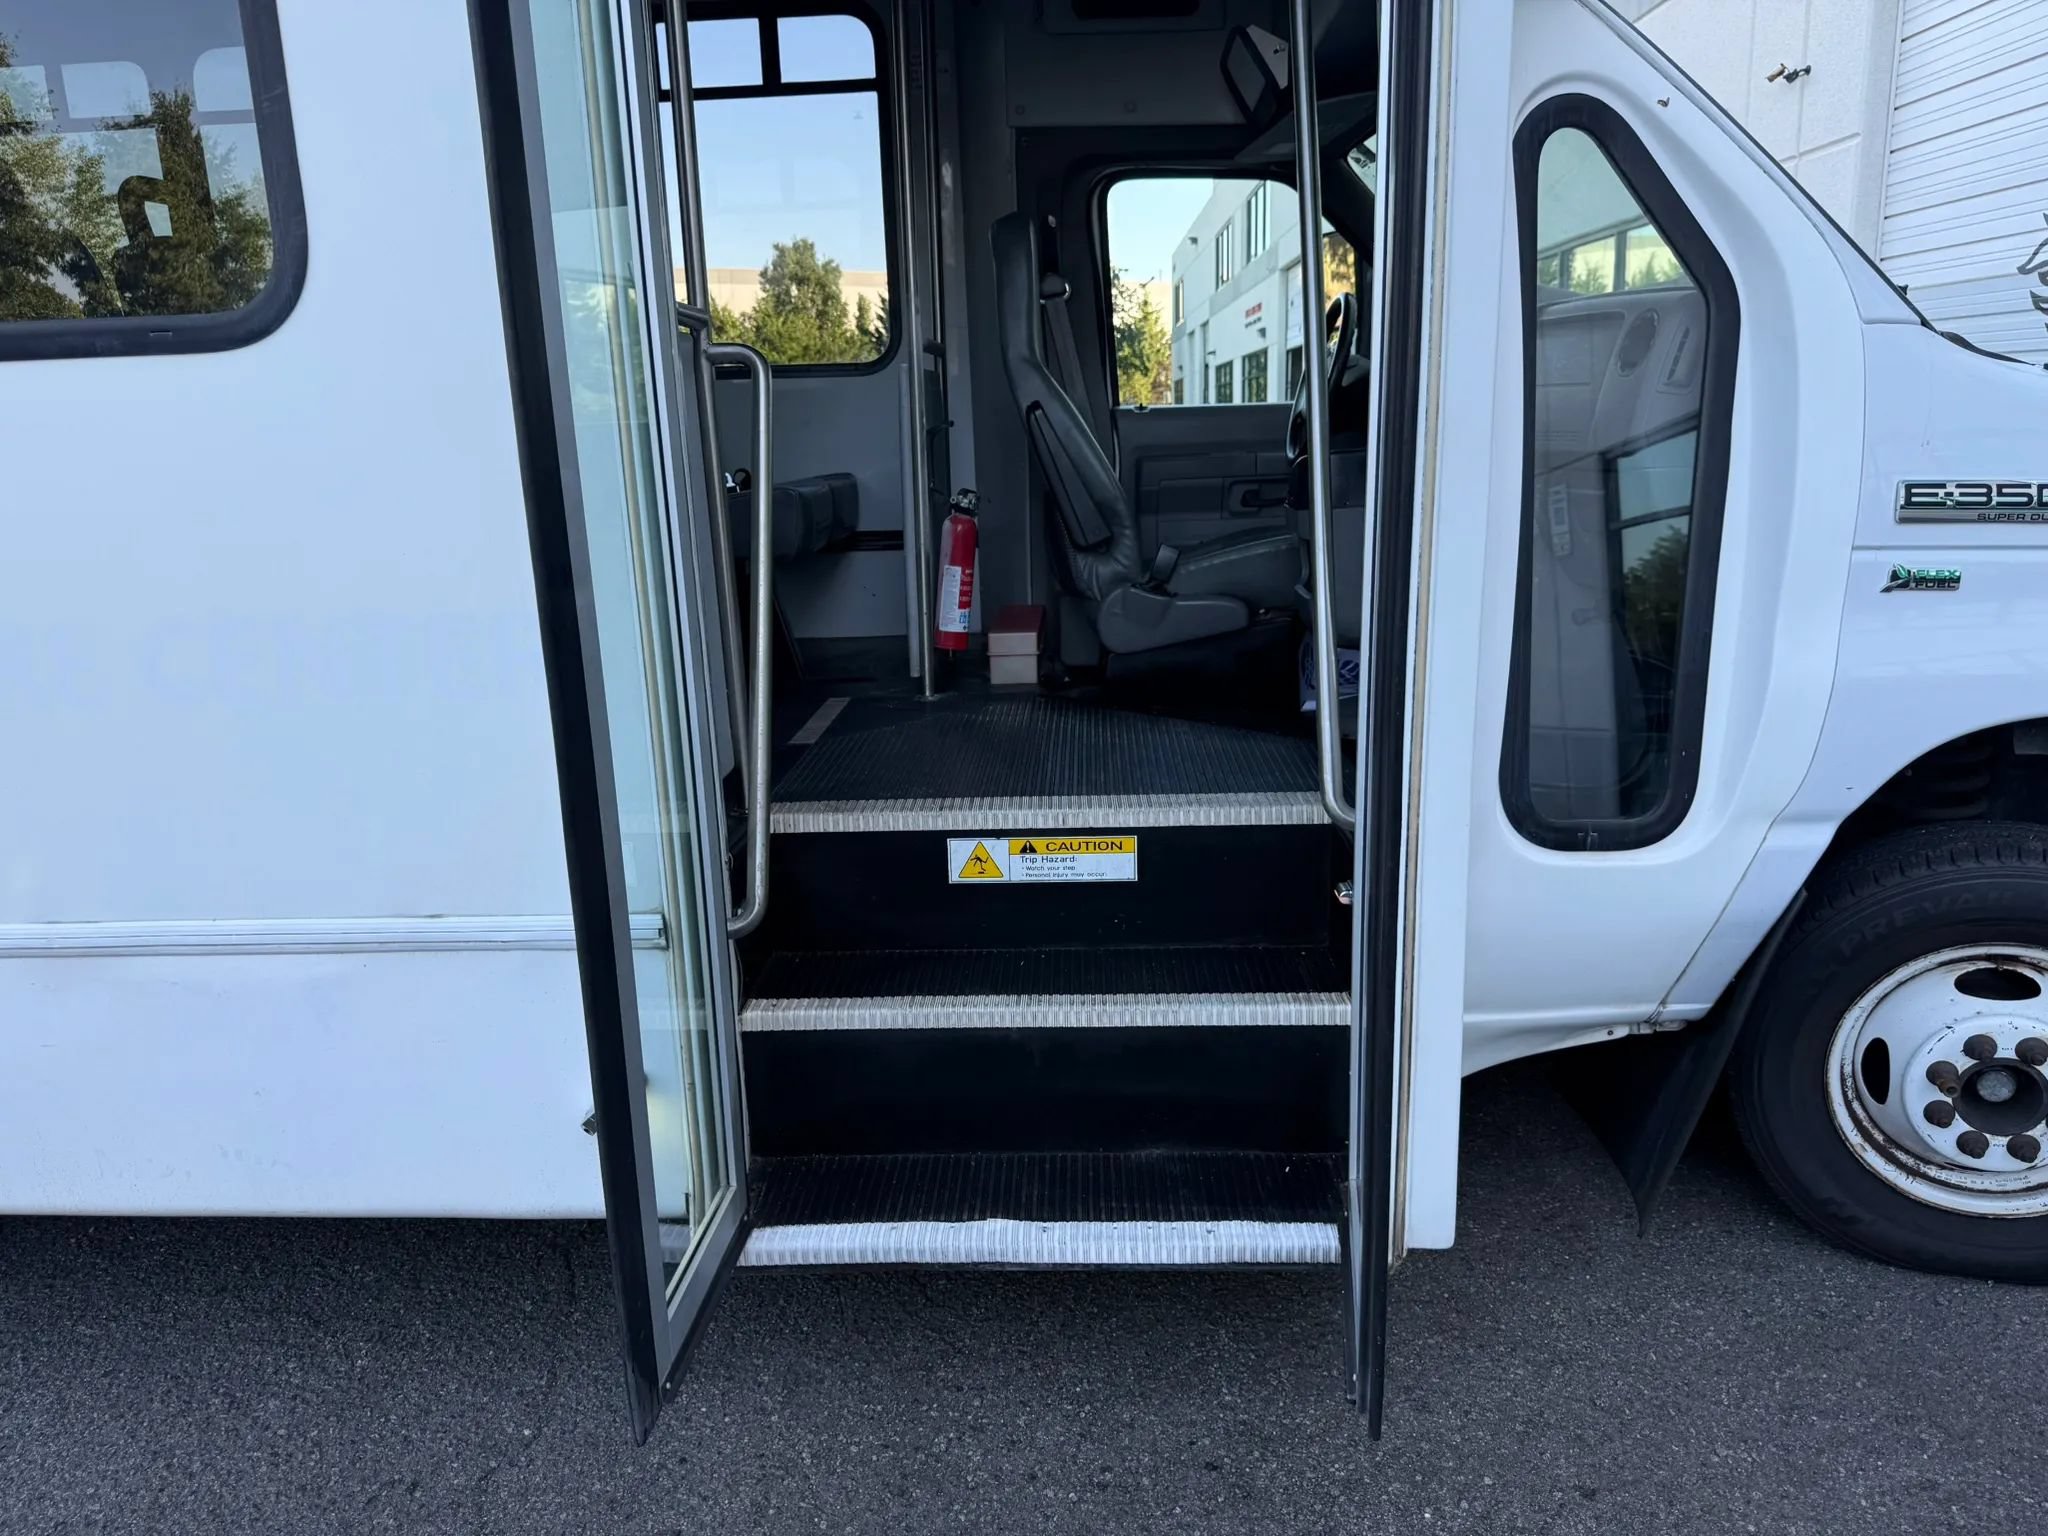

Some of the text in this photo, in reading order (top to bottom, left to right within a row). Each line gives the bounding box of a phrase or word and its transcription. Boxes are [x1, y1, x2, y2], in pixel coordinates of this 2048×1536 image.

[1977, 513, 2026, 521] SUPER
[1915, 569, 1959, 580] FLEX
[1915, 580, 1957, 589] FUEL
[1046, 840, 1123, 852] CAUTION
[1021, 855, 1038, 865] Trip
[1062, 865, 1076, 873] step
